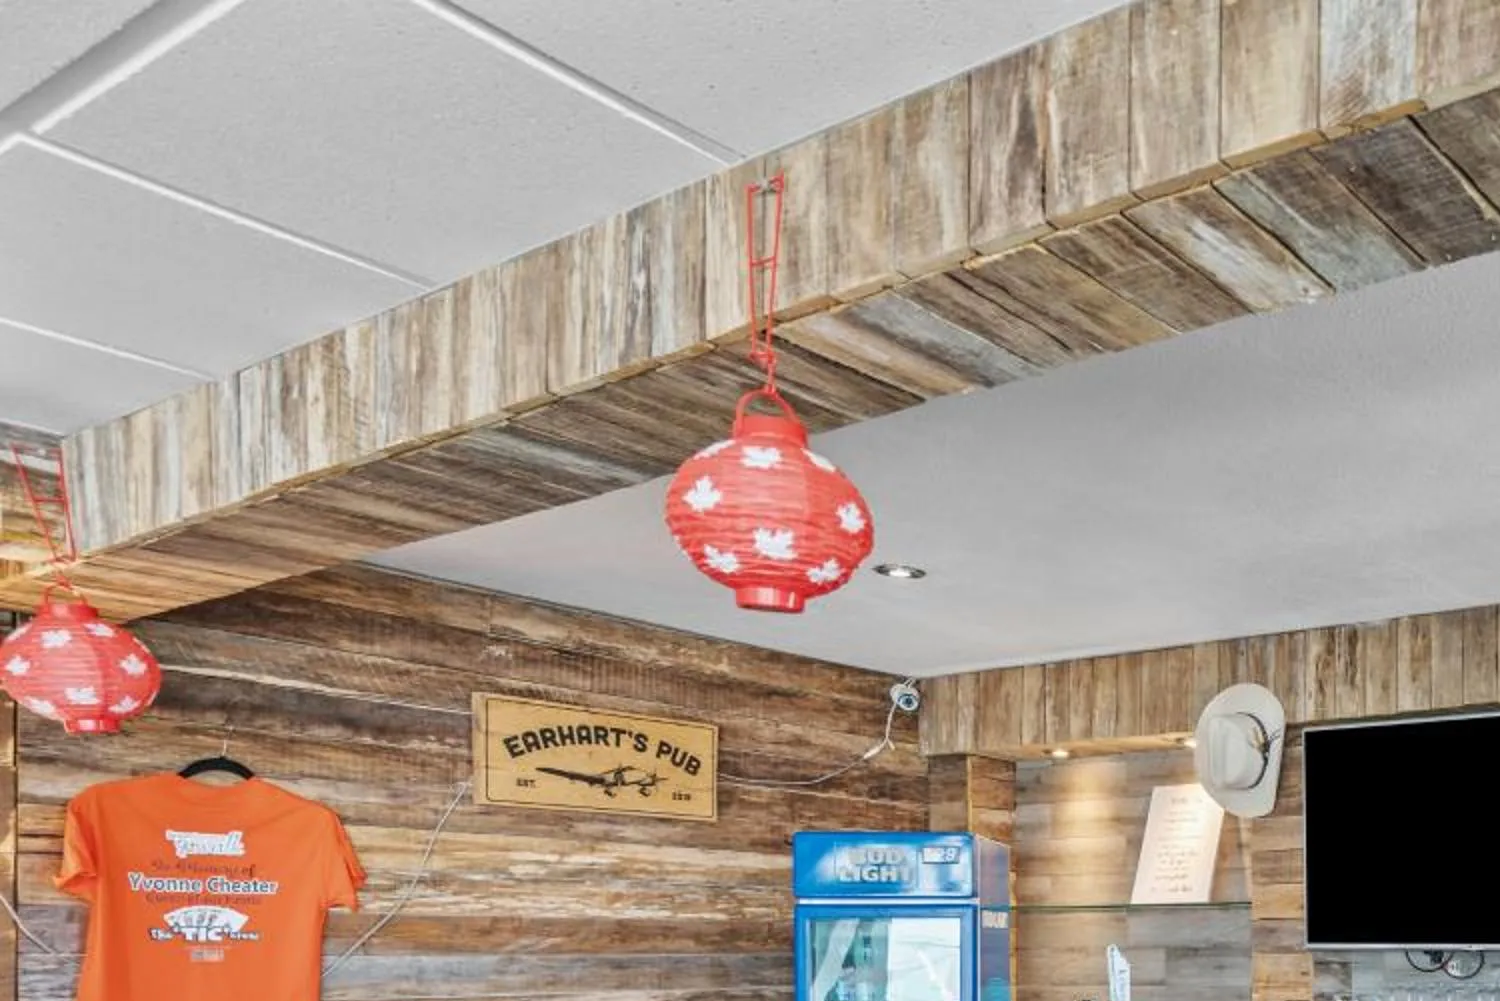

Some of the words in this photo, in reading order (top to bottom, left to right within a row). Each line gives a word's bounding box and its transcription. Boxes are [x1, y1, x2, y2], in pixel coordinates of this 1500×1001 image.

[503, 725, 649, 758] EARHART'S
[655, 740, 702, 776] PUB
[128, 872, 202, 892] Yvonne
[207, 875, 279, 894] Cheater
[839, 864, 913, 883] LIGHT
